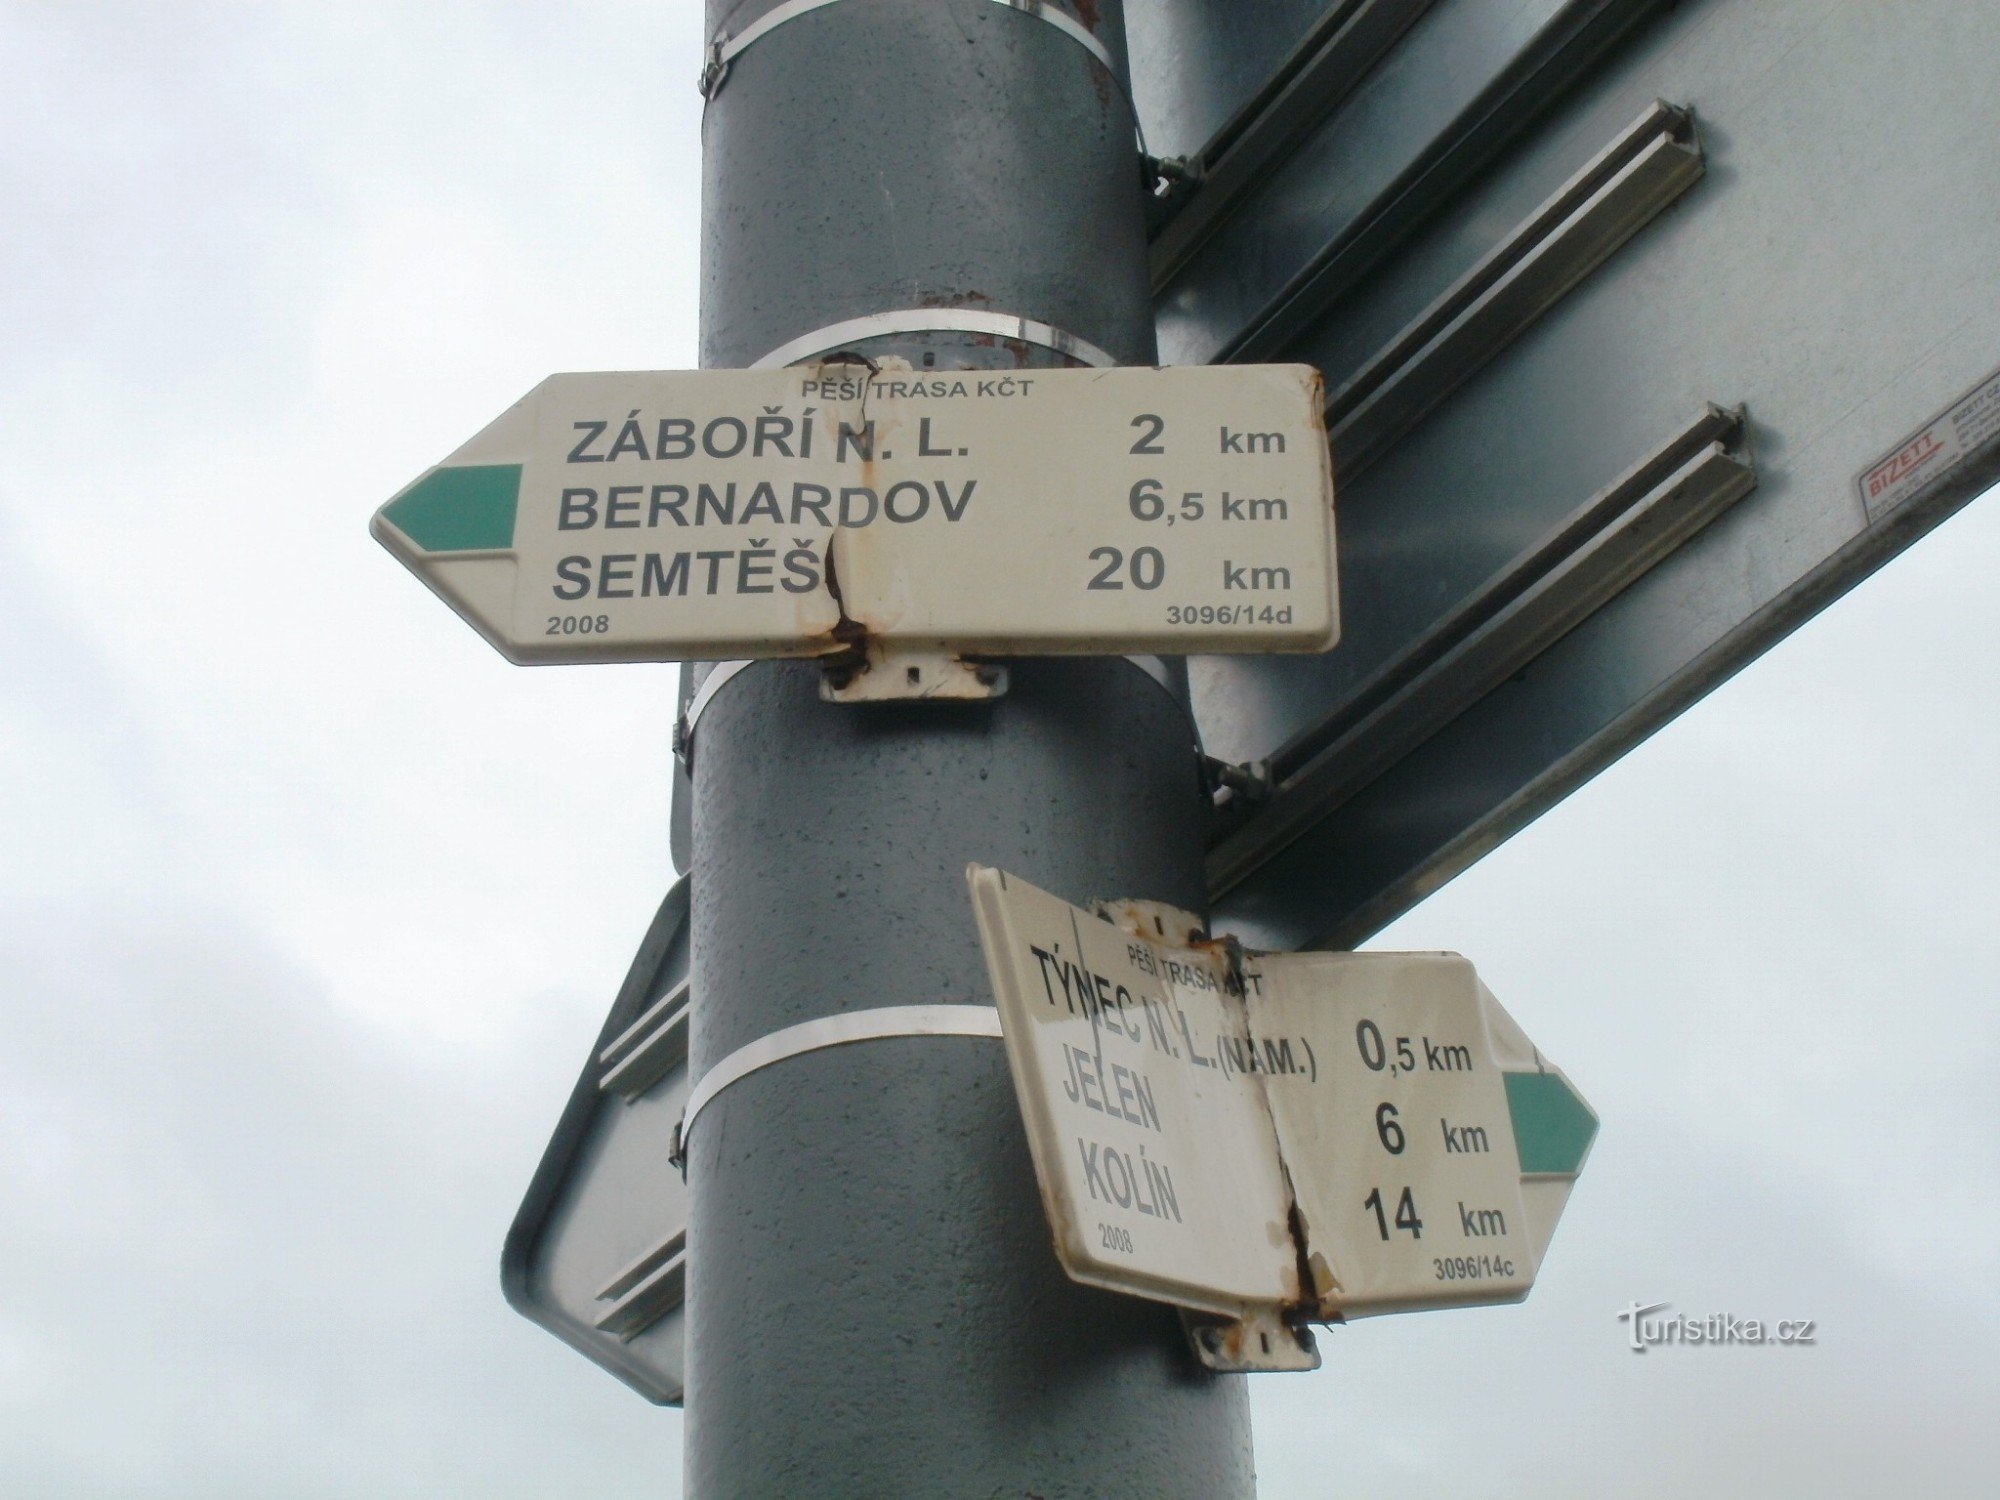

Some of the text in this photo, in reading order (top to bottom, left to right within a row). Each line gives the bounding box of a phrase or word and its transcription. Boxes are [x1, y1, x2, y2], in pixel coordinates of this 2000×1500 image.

[801, 376, 1034, 401] PĚŠÍ TRASA KČT
[566, 405, 1286, 464] ZÁBOŘÍ N. L. 2 km
[1868, 431, 1934, 497] BIZETT
[557, 478, 1288, 531] BERNARDOV 6,5 km
[552, 538, 1291, 601] SEMTĚŠ 20 km
[545, 614, 610, 636] 2008
[1166, 605, 1293, 625] 3096/14d
[1160, 959, 1219, 993] TRASA
[1030, 943, 1141, 1043] TÝNEC
[1356, 1019, 1416, 1078] 0,5
[1423, 1037, 1472, 1071] km
[1062, 1043, 1490, 1155] JELEN 6 km
[1077, 1137, 1507, 1241] KOLÍN 14 km
[1098, 1222, 1133, 1254] 2008
[1433, 1255, 1515, 1280] 3096/14c
